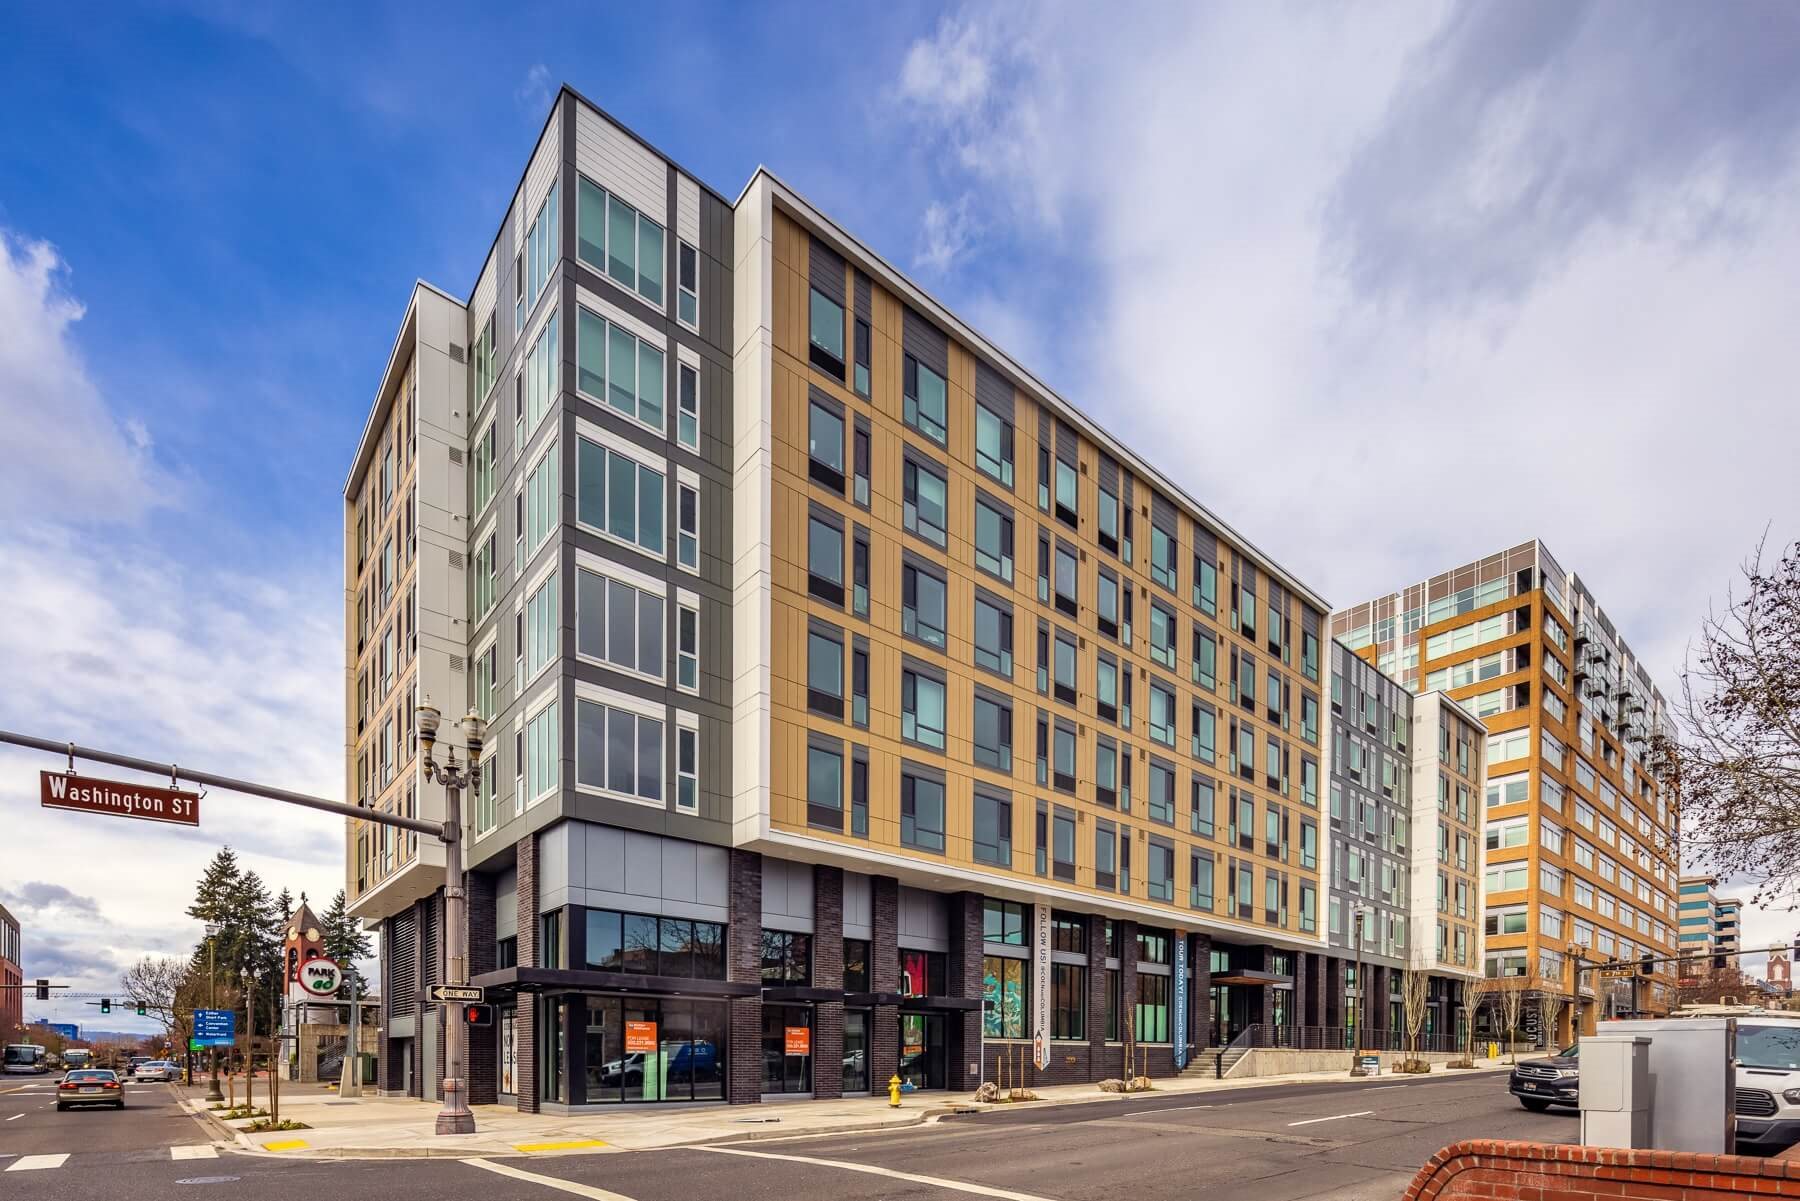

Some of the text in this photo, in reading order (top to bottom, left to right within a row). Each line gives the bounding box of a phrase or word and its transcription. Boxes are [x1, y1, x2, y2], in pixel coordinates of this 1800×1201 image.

[49, 776, 193, 815] Washington ST
[307, 967, 335, 977] PARK
[312, 980, 334, 990] GO
